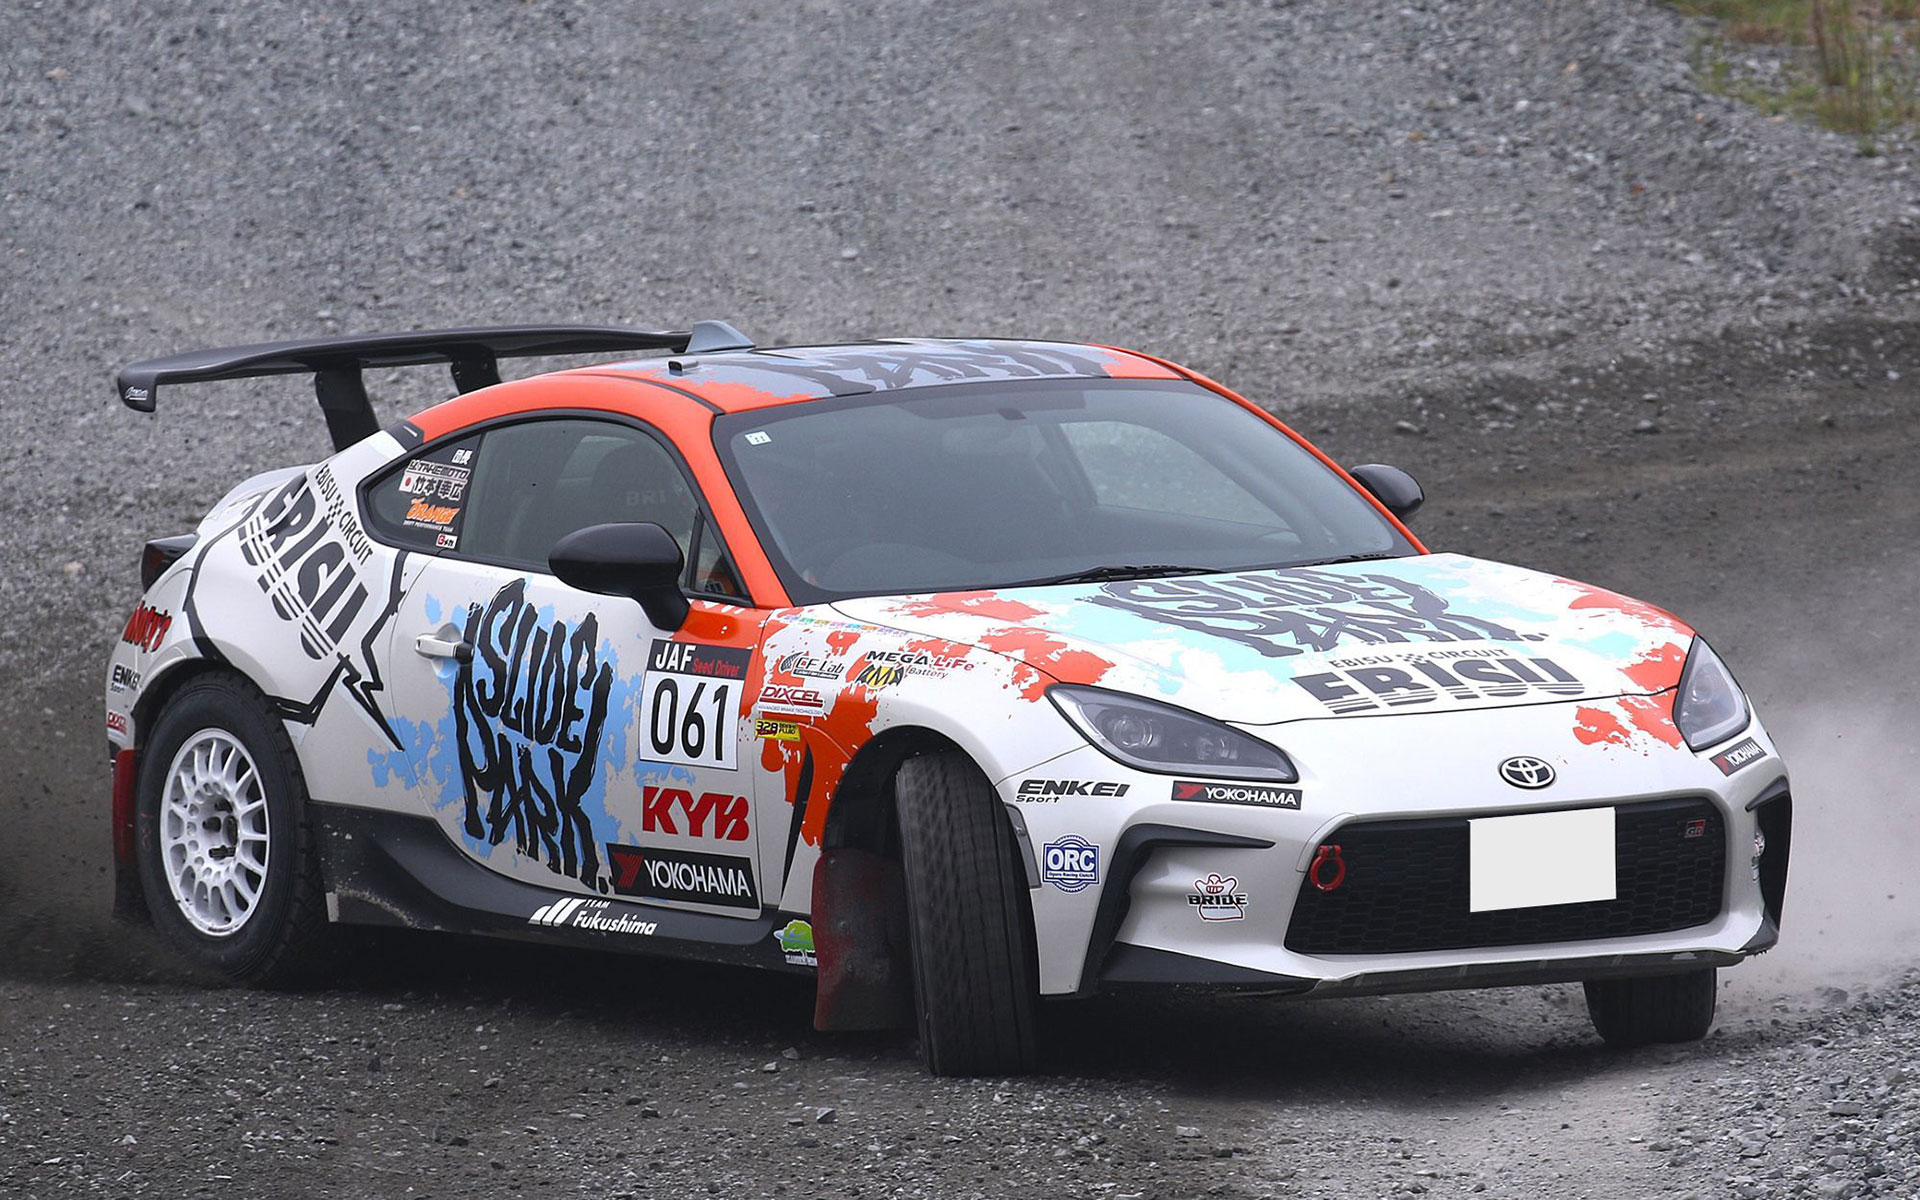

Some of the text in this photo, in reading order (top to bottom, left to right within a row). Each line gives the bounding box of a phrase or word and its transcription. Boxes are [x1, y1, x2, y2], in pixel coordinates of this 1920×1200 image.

[314, 463, 373, 566] EBISU CIRCUIT
[406, 503, 460, 524] ORANGE
[476, 578, 599, 755] SLIDE
[655, 642, 740, 676] JAF Seed Driver
[820, 659, 844, 674] Lab
[866, 650, 929, 665] MEGA
[1328, 649, 1510, 668] EBISU CIRCUIT
[908, 667, 949, 679] Battery
[761, 686, 824, 703] DIXCEL
[1290, 657, 1586, 714] EBISU
[650, 678, 729, 761] 061
[757, 720, 778, 732] 328
[1725, 741, 1762, 767] YOKOHAMA
[1018, 779, 1131, 797] ENKEI
[1204, 786, 1298, 806] YOKOHAMA
[1015, 795, 1060, 804] Sport
[642, 786, 750, 841] KYB
[1047, 849, 1095, 871] ORC
[644, 859, 752, 897] YOKOHAMA
[585, 899, 611, 908] TEAM
[1187, 894, 1248, 905] BRIDE
[573, 910, 657, 935] Fukushima
